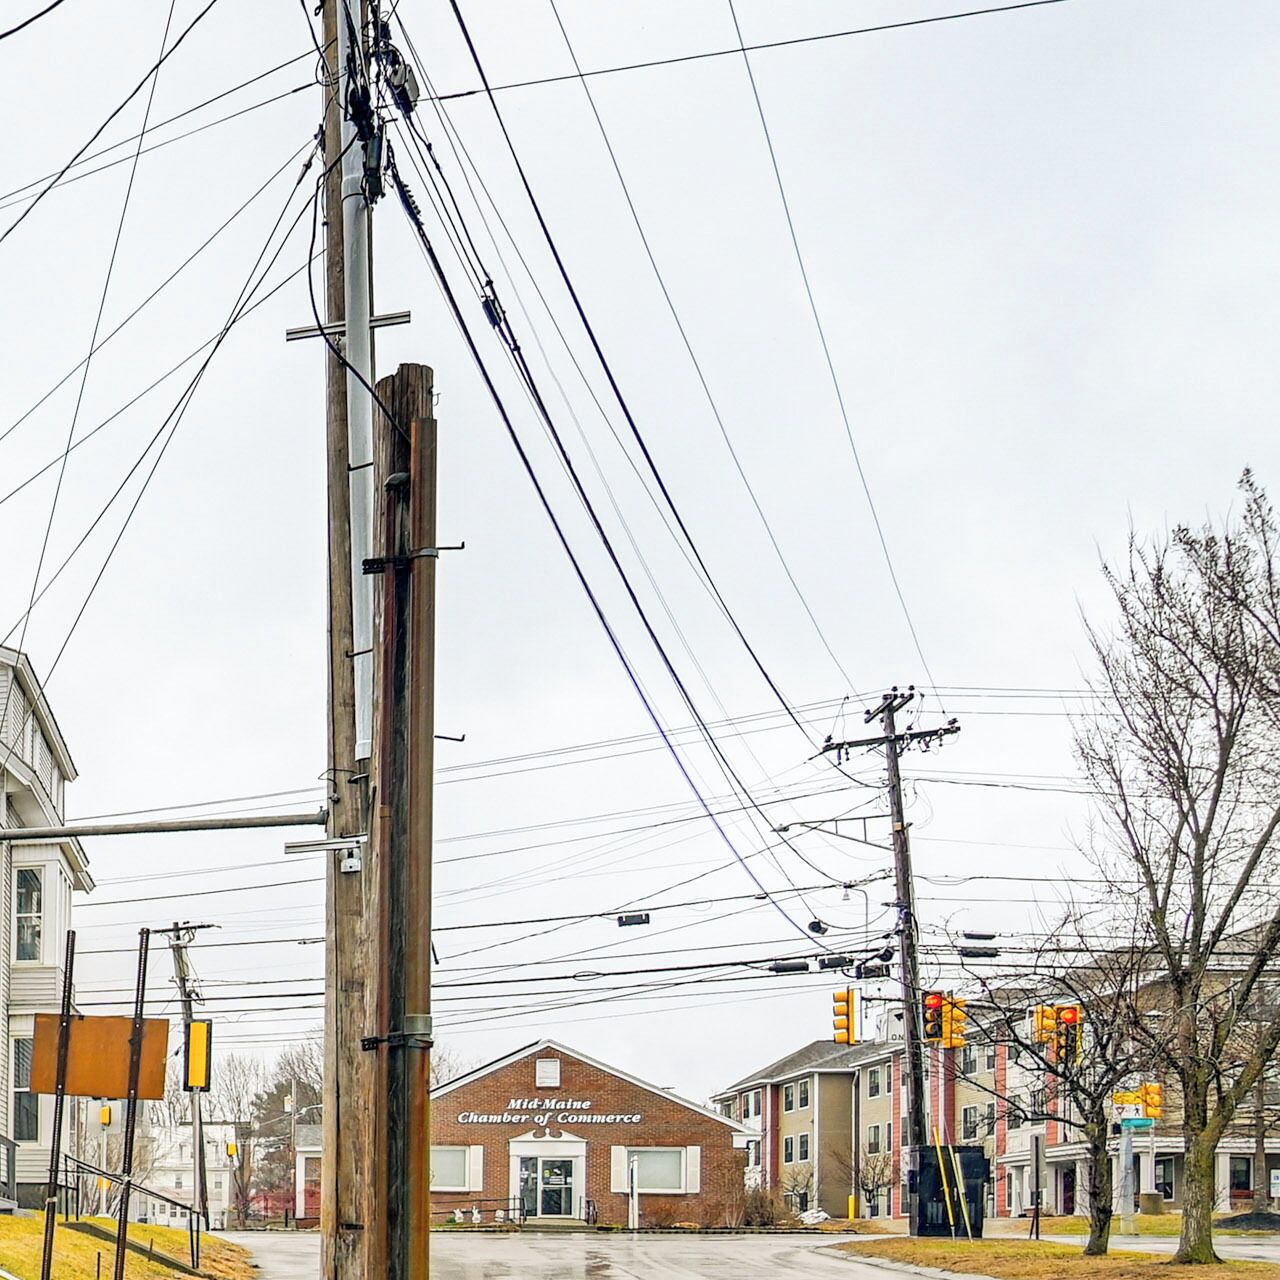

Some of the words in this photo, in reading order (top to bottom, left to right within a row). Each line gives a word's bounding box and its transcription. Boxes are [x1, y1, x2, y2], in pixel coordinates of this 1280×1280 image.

[507, 1098, 592, 1110] Mid-Maine
[457, 1111, 530, 1124] Chamber
[534, 1112, 553, 1126] of
[557, 1111, 642, 1124] Commerce
